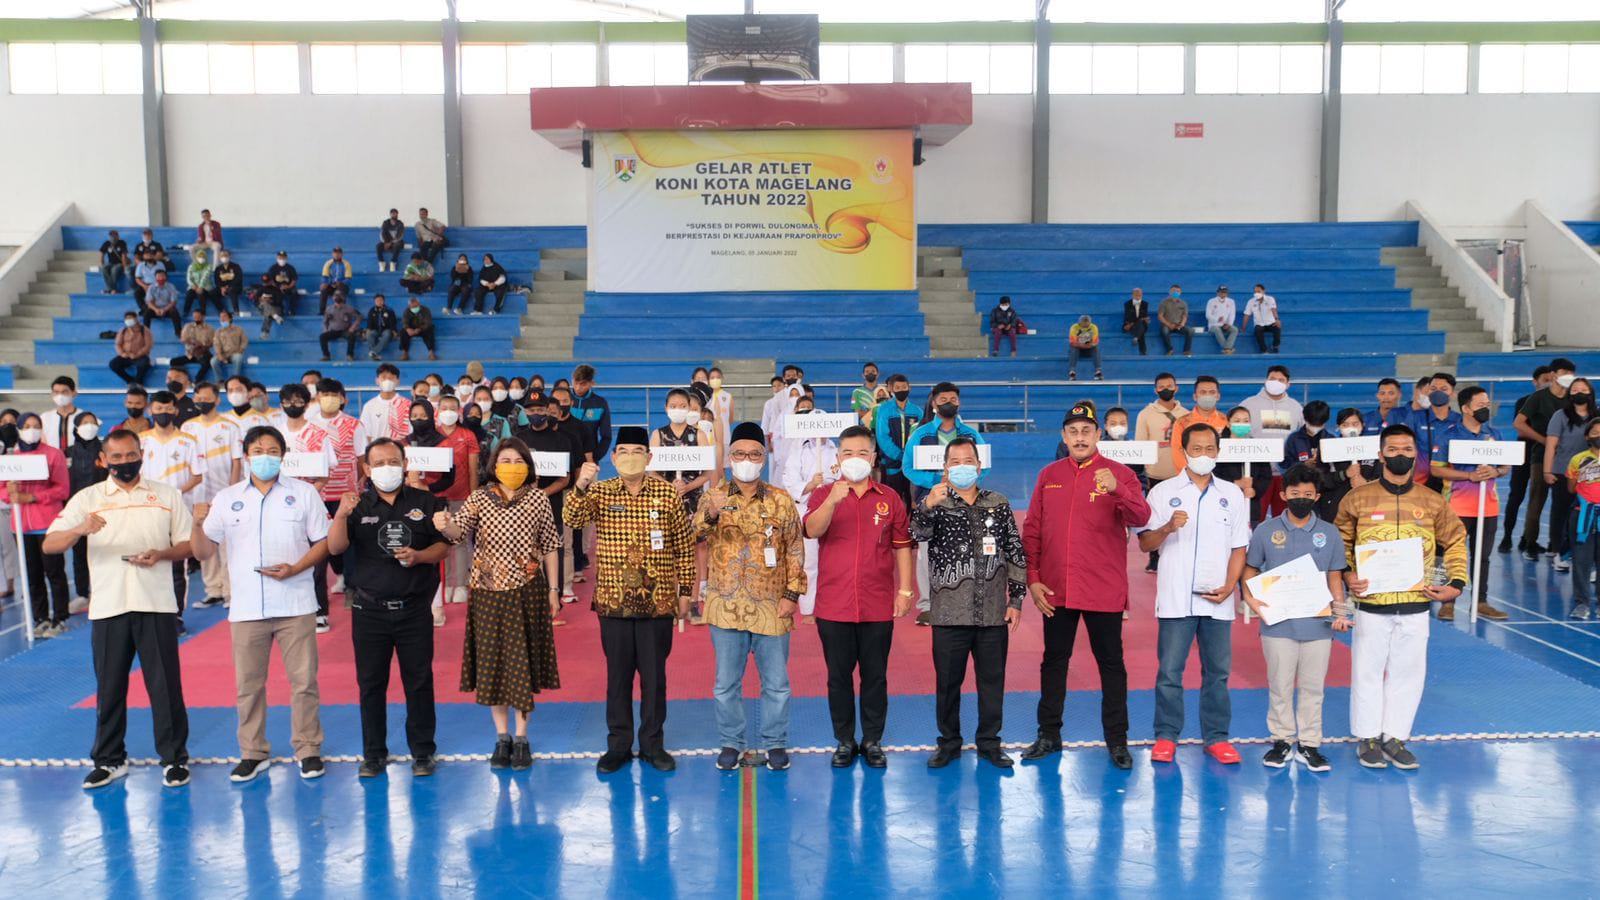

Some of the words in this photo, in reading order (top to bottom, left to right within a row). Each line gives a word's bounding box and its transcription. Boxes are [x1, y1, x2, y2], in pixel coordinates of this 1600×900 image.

[695, 162, 753, 175] GELAR
[758, 162, 812, 175] ATLET
[655, 178, 698, 190] KONI
[704, 178, 750, 190] KOTA
[755, 178, 852, 190] MAGELANG
[701, 193, 760, 206] TAHUN
[766, 193, 806, 206] 2022
[797, 420, 842, 430] PERKEMI
[1100, 449, 1144, 458] PERSANI
[1228, 445, 1271, 455] PERTINA
[1471, 447, 1504, 456] POBSI
[658, 453, 702, 462] PERBASI
[283, 459, 300, 468] BSI
